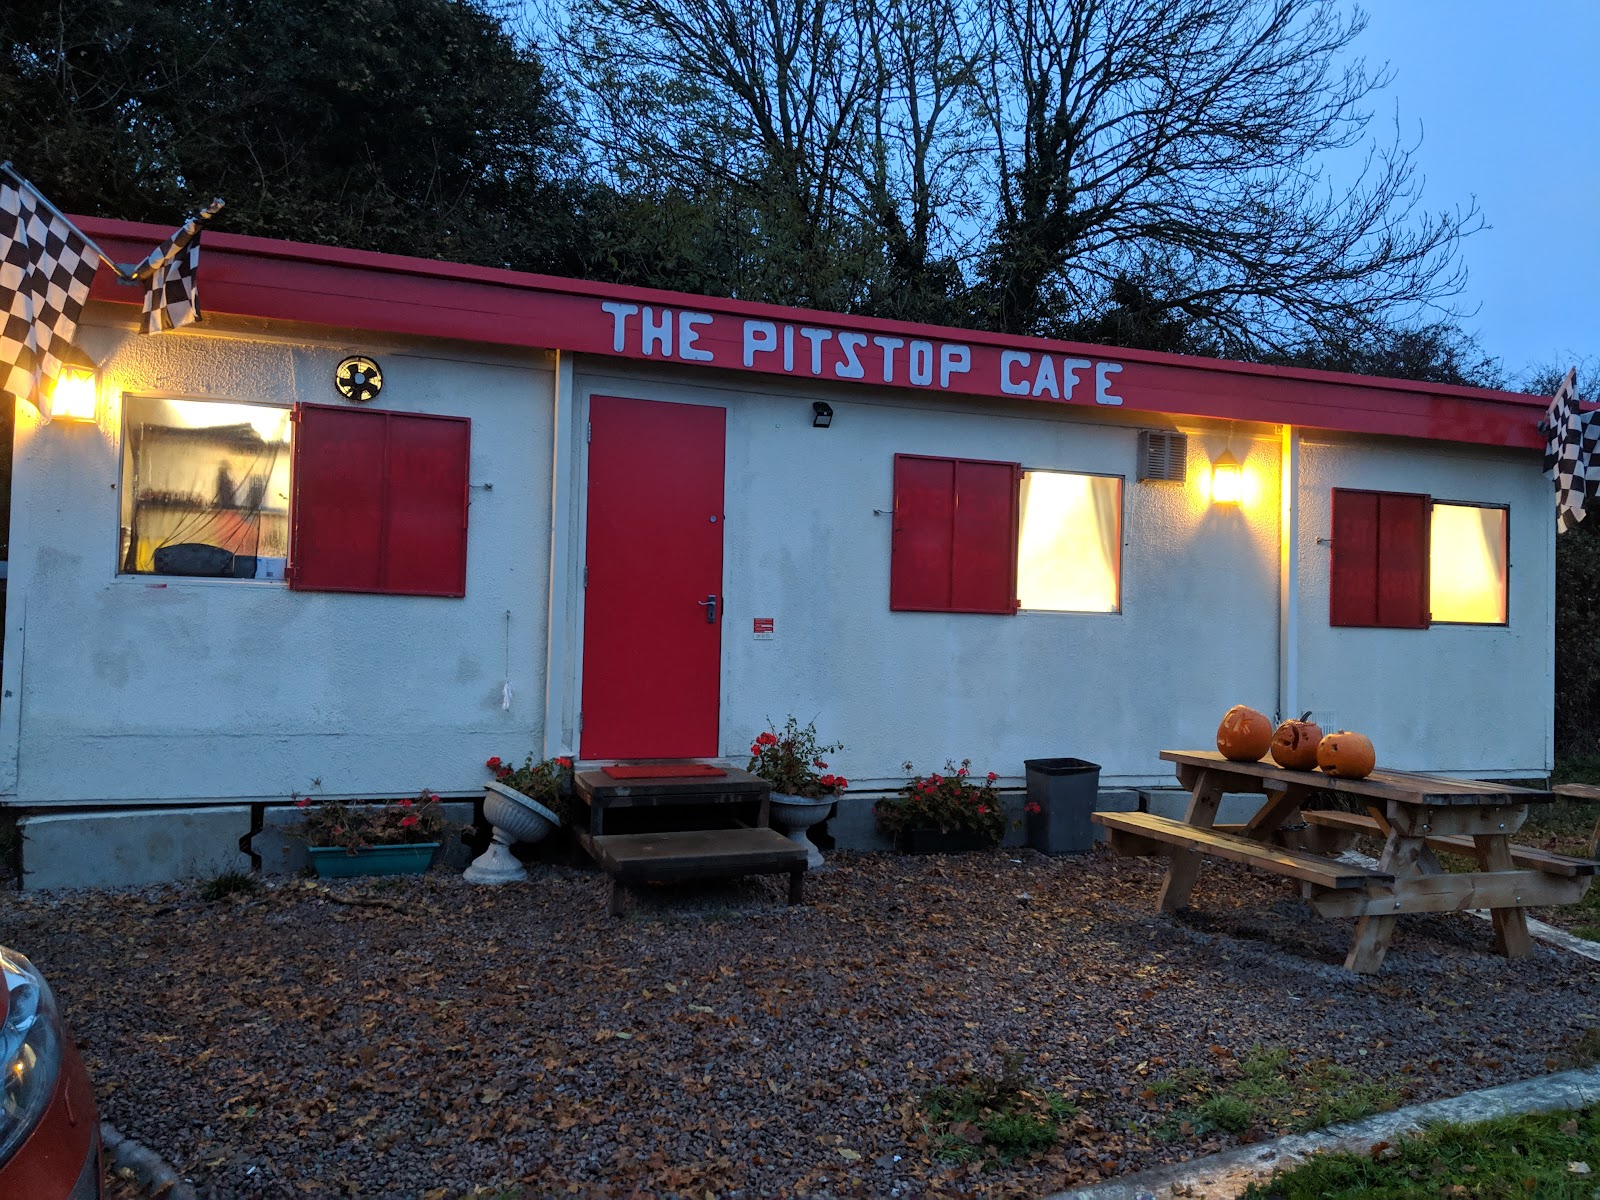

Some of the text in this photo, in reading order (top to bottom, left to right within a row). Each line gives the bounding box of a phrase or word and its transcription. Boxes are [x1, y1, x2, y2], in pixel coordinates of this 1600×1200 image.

[601, 302, 1123, 405] THE PITSTOP CAFE
